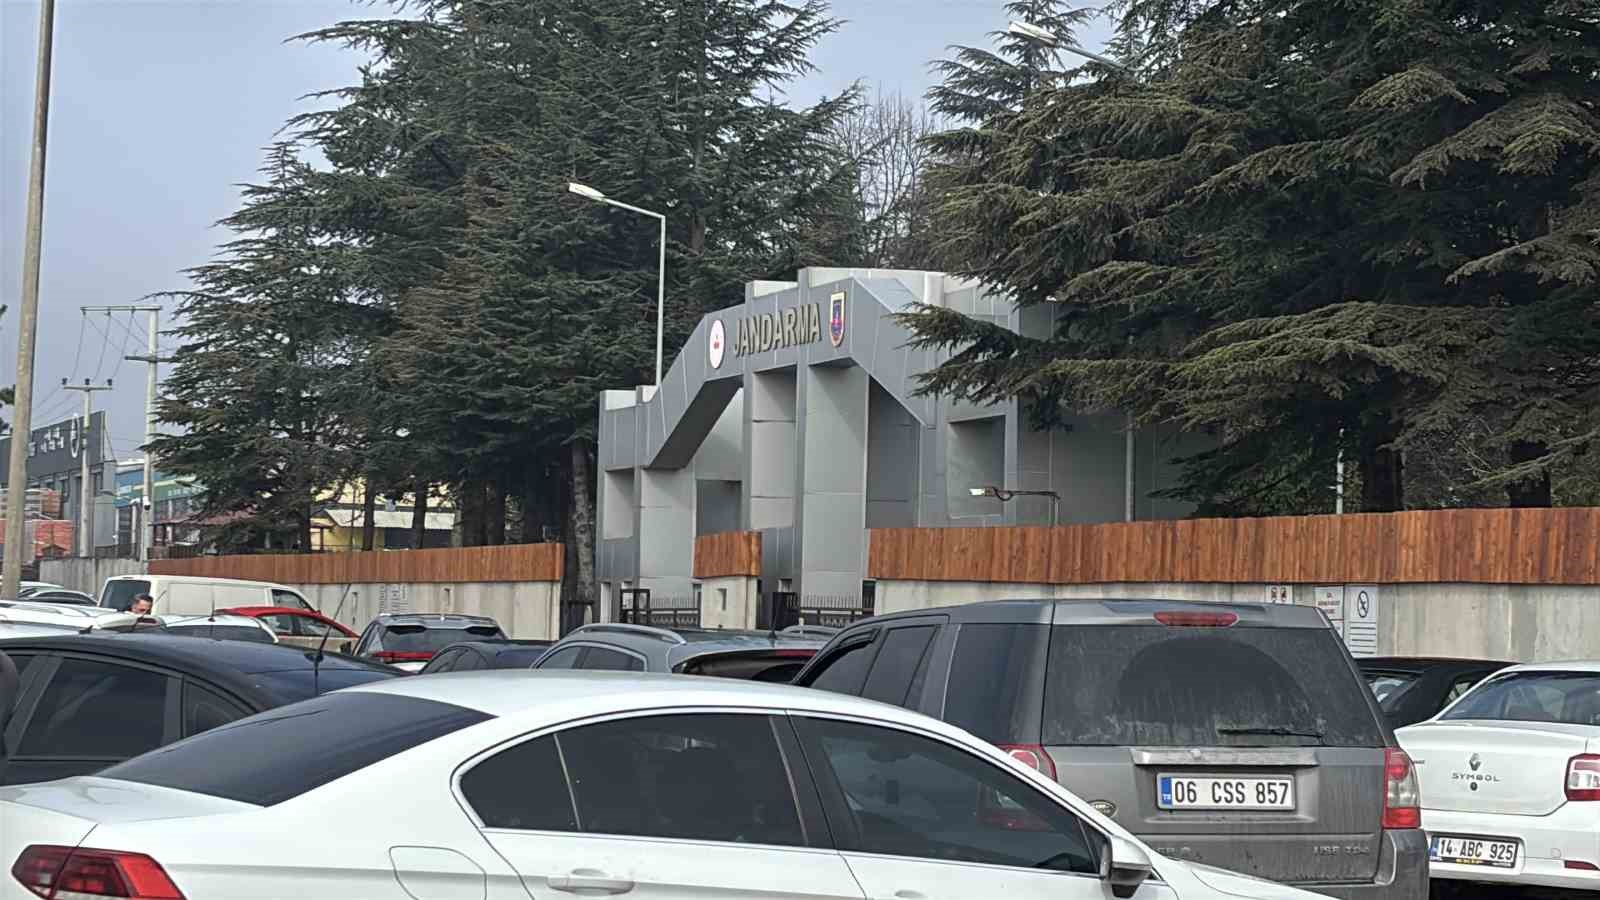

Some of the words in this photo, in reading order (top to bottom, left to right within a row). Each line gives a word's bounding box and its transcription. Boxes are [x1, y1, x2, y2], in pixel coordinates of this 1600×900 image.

[734, 303, 822, 357] JANDARMA
[1452, 772, 1500, 782] SYMBOL
[1174, 781, 1197, 803] 06
[1211, 781, 1245, 804] CSS
[1255, 782, 1289, 805] 857
[1440, 839, 1453, 856] 14
[1460, 840, 1484, 858] ABC
[1489, 843, 1514, 861] 925
